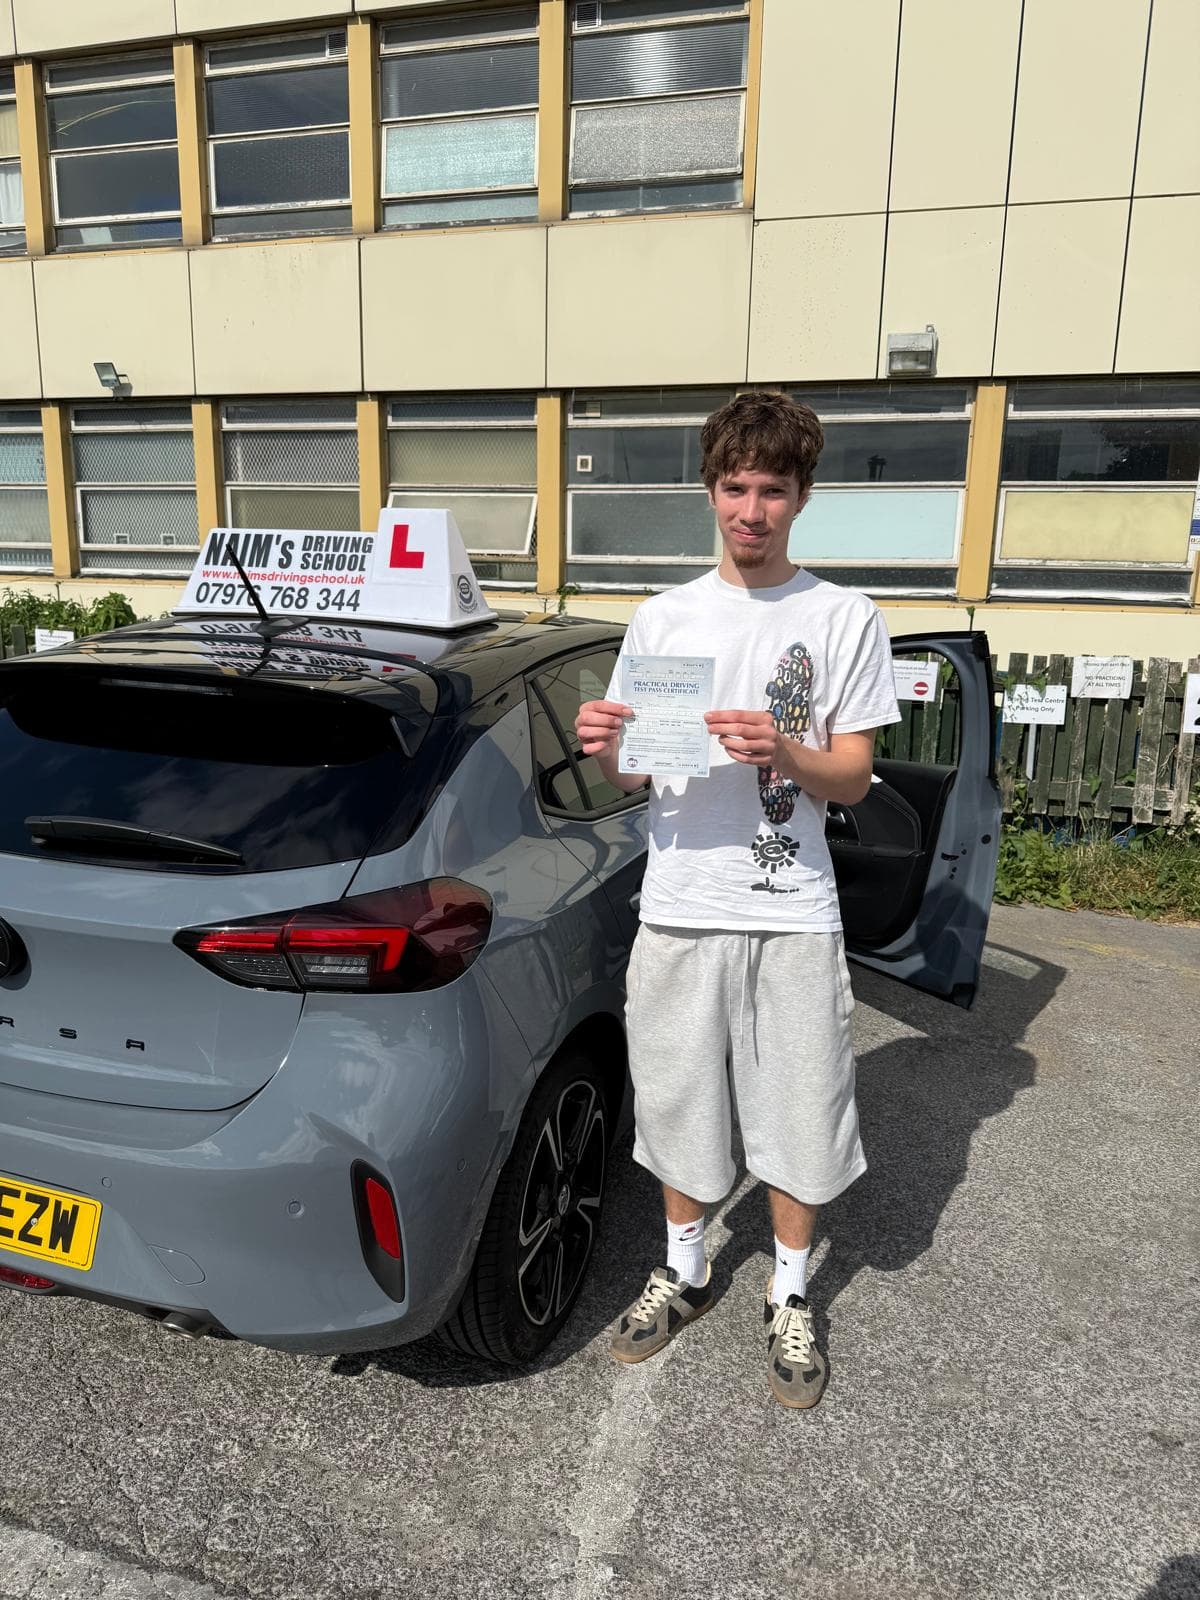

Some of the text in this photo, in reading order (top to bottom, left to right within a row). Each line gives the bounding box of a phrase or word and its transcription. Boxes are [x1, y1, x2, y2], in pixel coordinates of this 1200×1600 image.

[204, 532, 295, 570] NAIM's
[301, 535, 374, 554] DRIVING
[389, 523, 425, 569] L
[300, 553, 367, 572] SCHOOL
[202, 569, 366, 585] www.nimsdrivingschool.uk
[269, 586, 310, 609] 768
[316, 588, 361, 611] 344
